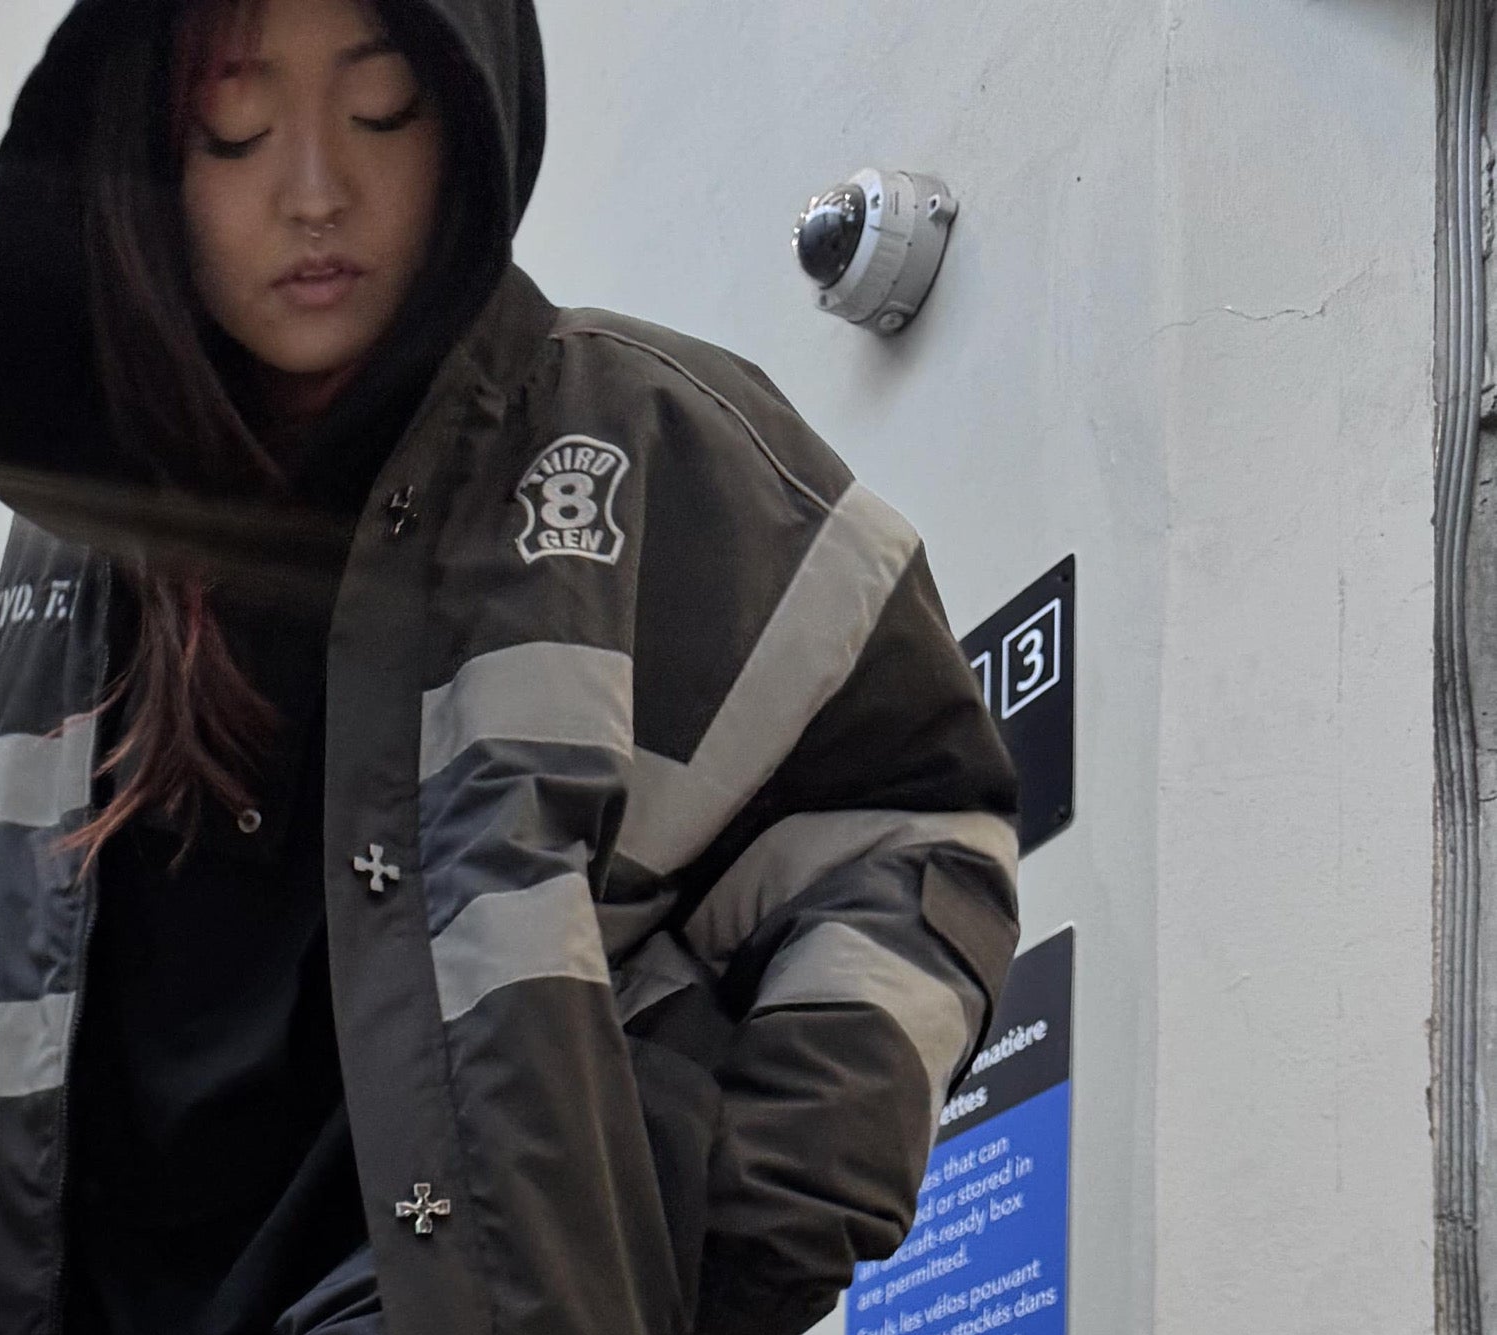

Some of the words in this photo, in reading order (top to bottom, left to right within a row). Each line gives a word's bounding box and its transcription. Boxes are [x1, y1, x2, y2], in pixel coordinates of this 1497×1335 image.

[541, 472, 599, 529] 8
[537, 527, 604, 551] GEN
[1016, 627, 1045, 693] 3
[971, 1019, 1048, 1074] matière
[939, 1085, 989, 1126] ettes
[936, 1194, 956, 1216] or
[957, 1159, 1012, 1206] stored
[1015, 1154, 1034, 1179] in
[943, 1150, 977, 1182] that
[977, 1136, 1010, 1164] can
[989, 1192, 1024, 1222] box
[857, 1286, 884, 1311] are
[885, 1244, 971, 1304] permitted.
[899, 1311, 925, 1334] les
[924, 1293, 969, 1324] vélos
[969, 1258, 1042, 1312] pouvant
[1014, 1287, 1058, 1318] dans
